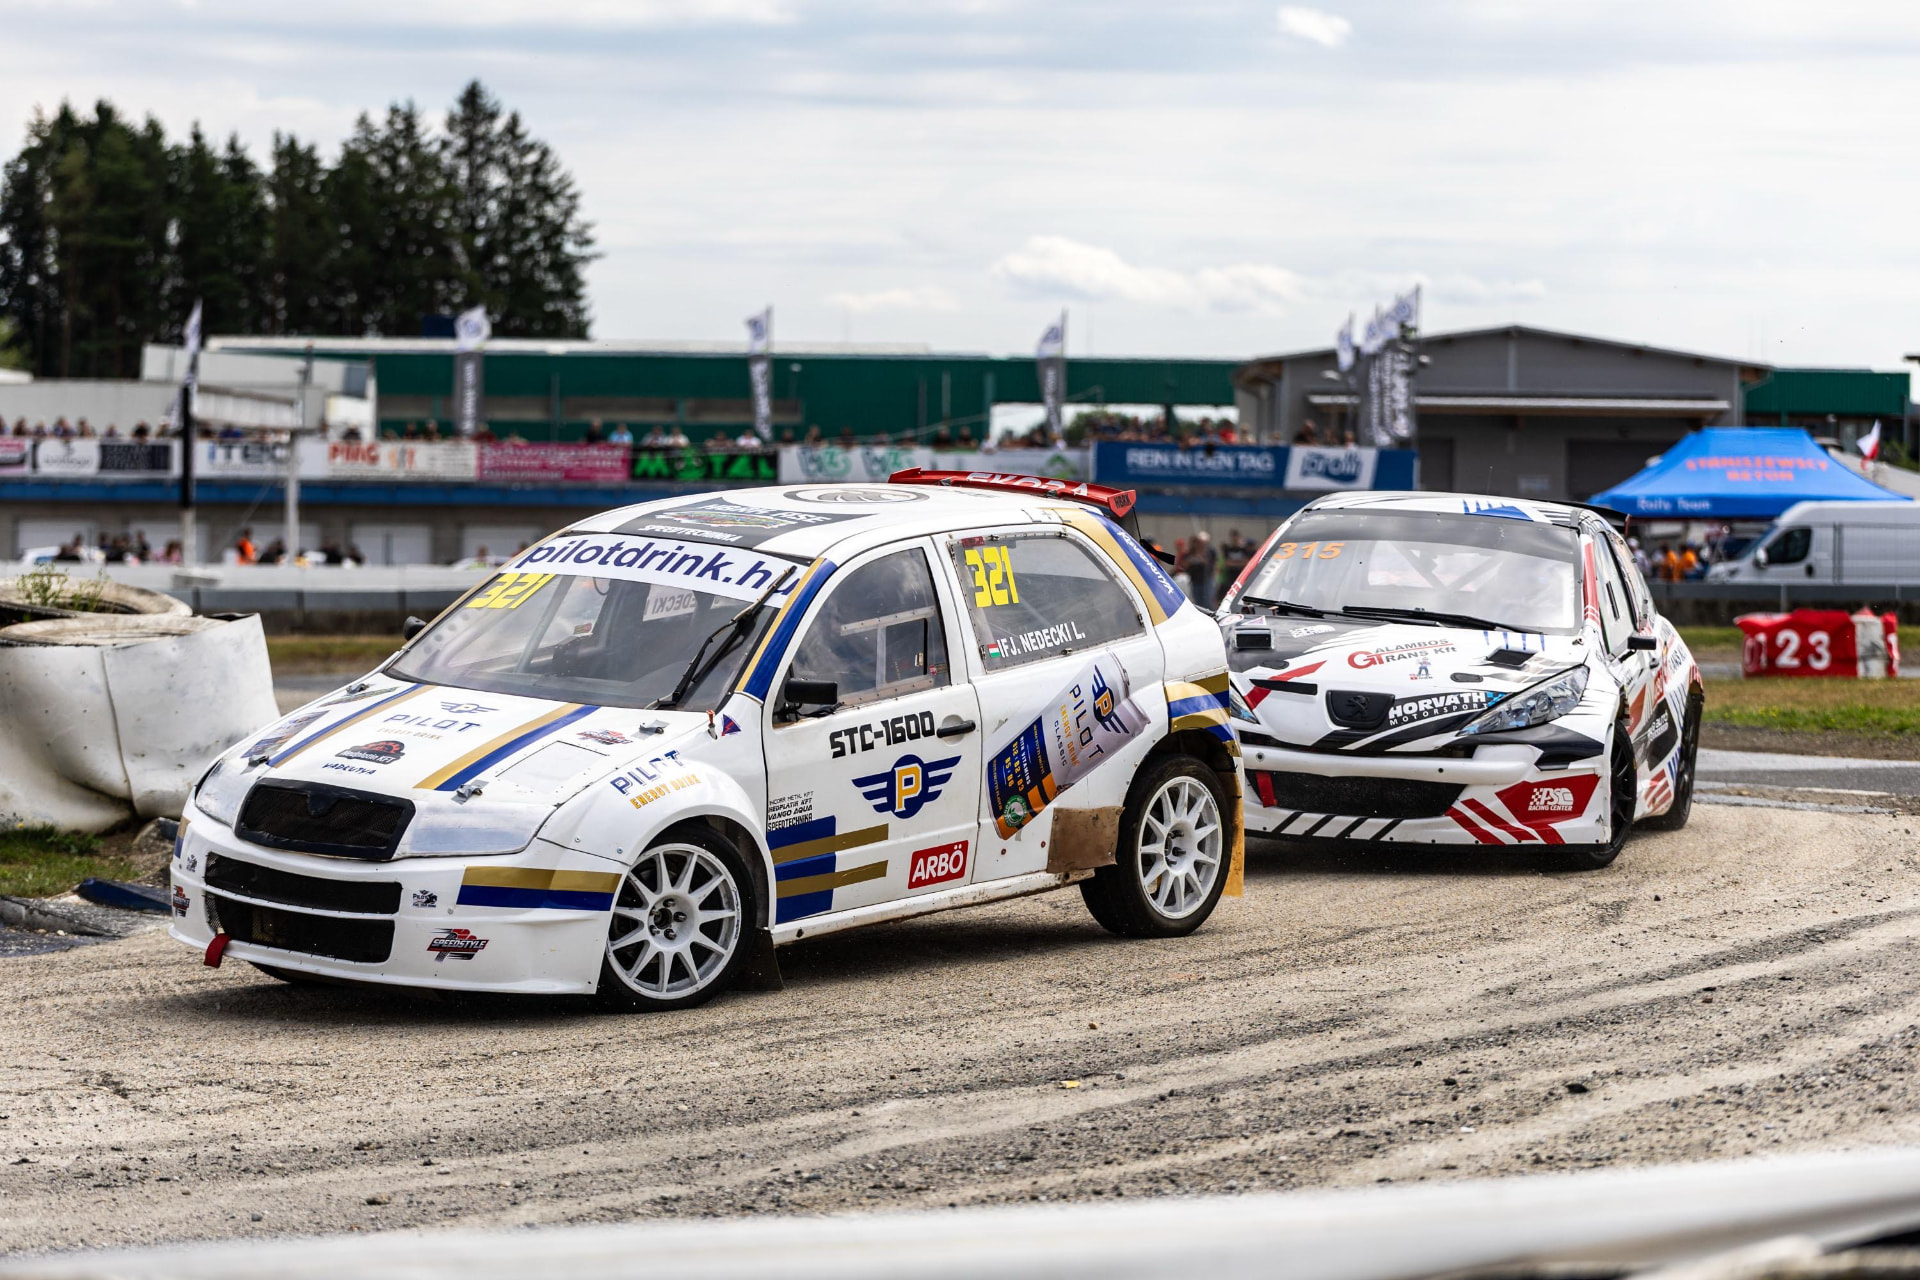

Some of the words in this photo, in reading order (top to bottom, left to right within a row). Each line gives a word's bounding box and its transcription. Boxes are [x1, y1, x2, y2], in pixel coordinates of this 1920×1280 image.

[515, 538, 799, 597] pilotdrink.hu
[1273, 542, 1345, 560] 315
[465, 573, 556, 609] 321
[965, 545, 1020, 608] 321
[1017, 623, 1072, 654] NEDECKI
[383, 713, 481, 732] PILOT
[829, 710, 936, 759] STC-1600
[1069, 683, 1105, 762] PILOT
[911, 843, 964, 884] ARBÖ
[431, 939, 487, 949] SPEEDSTYLE
